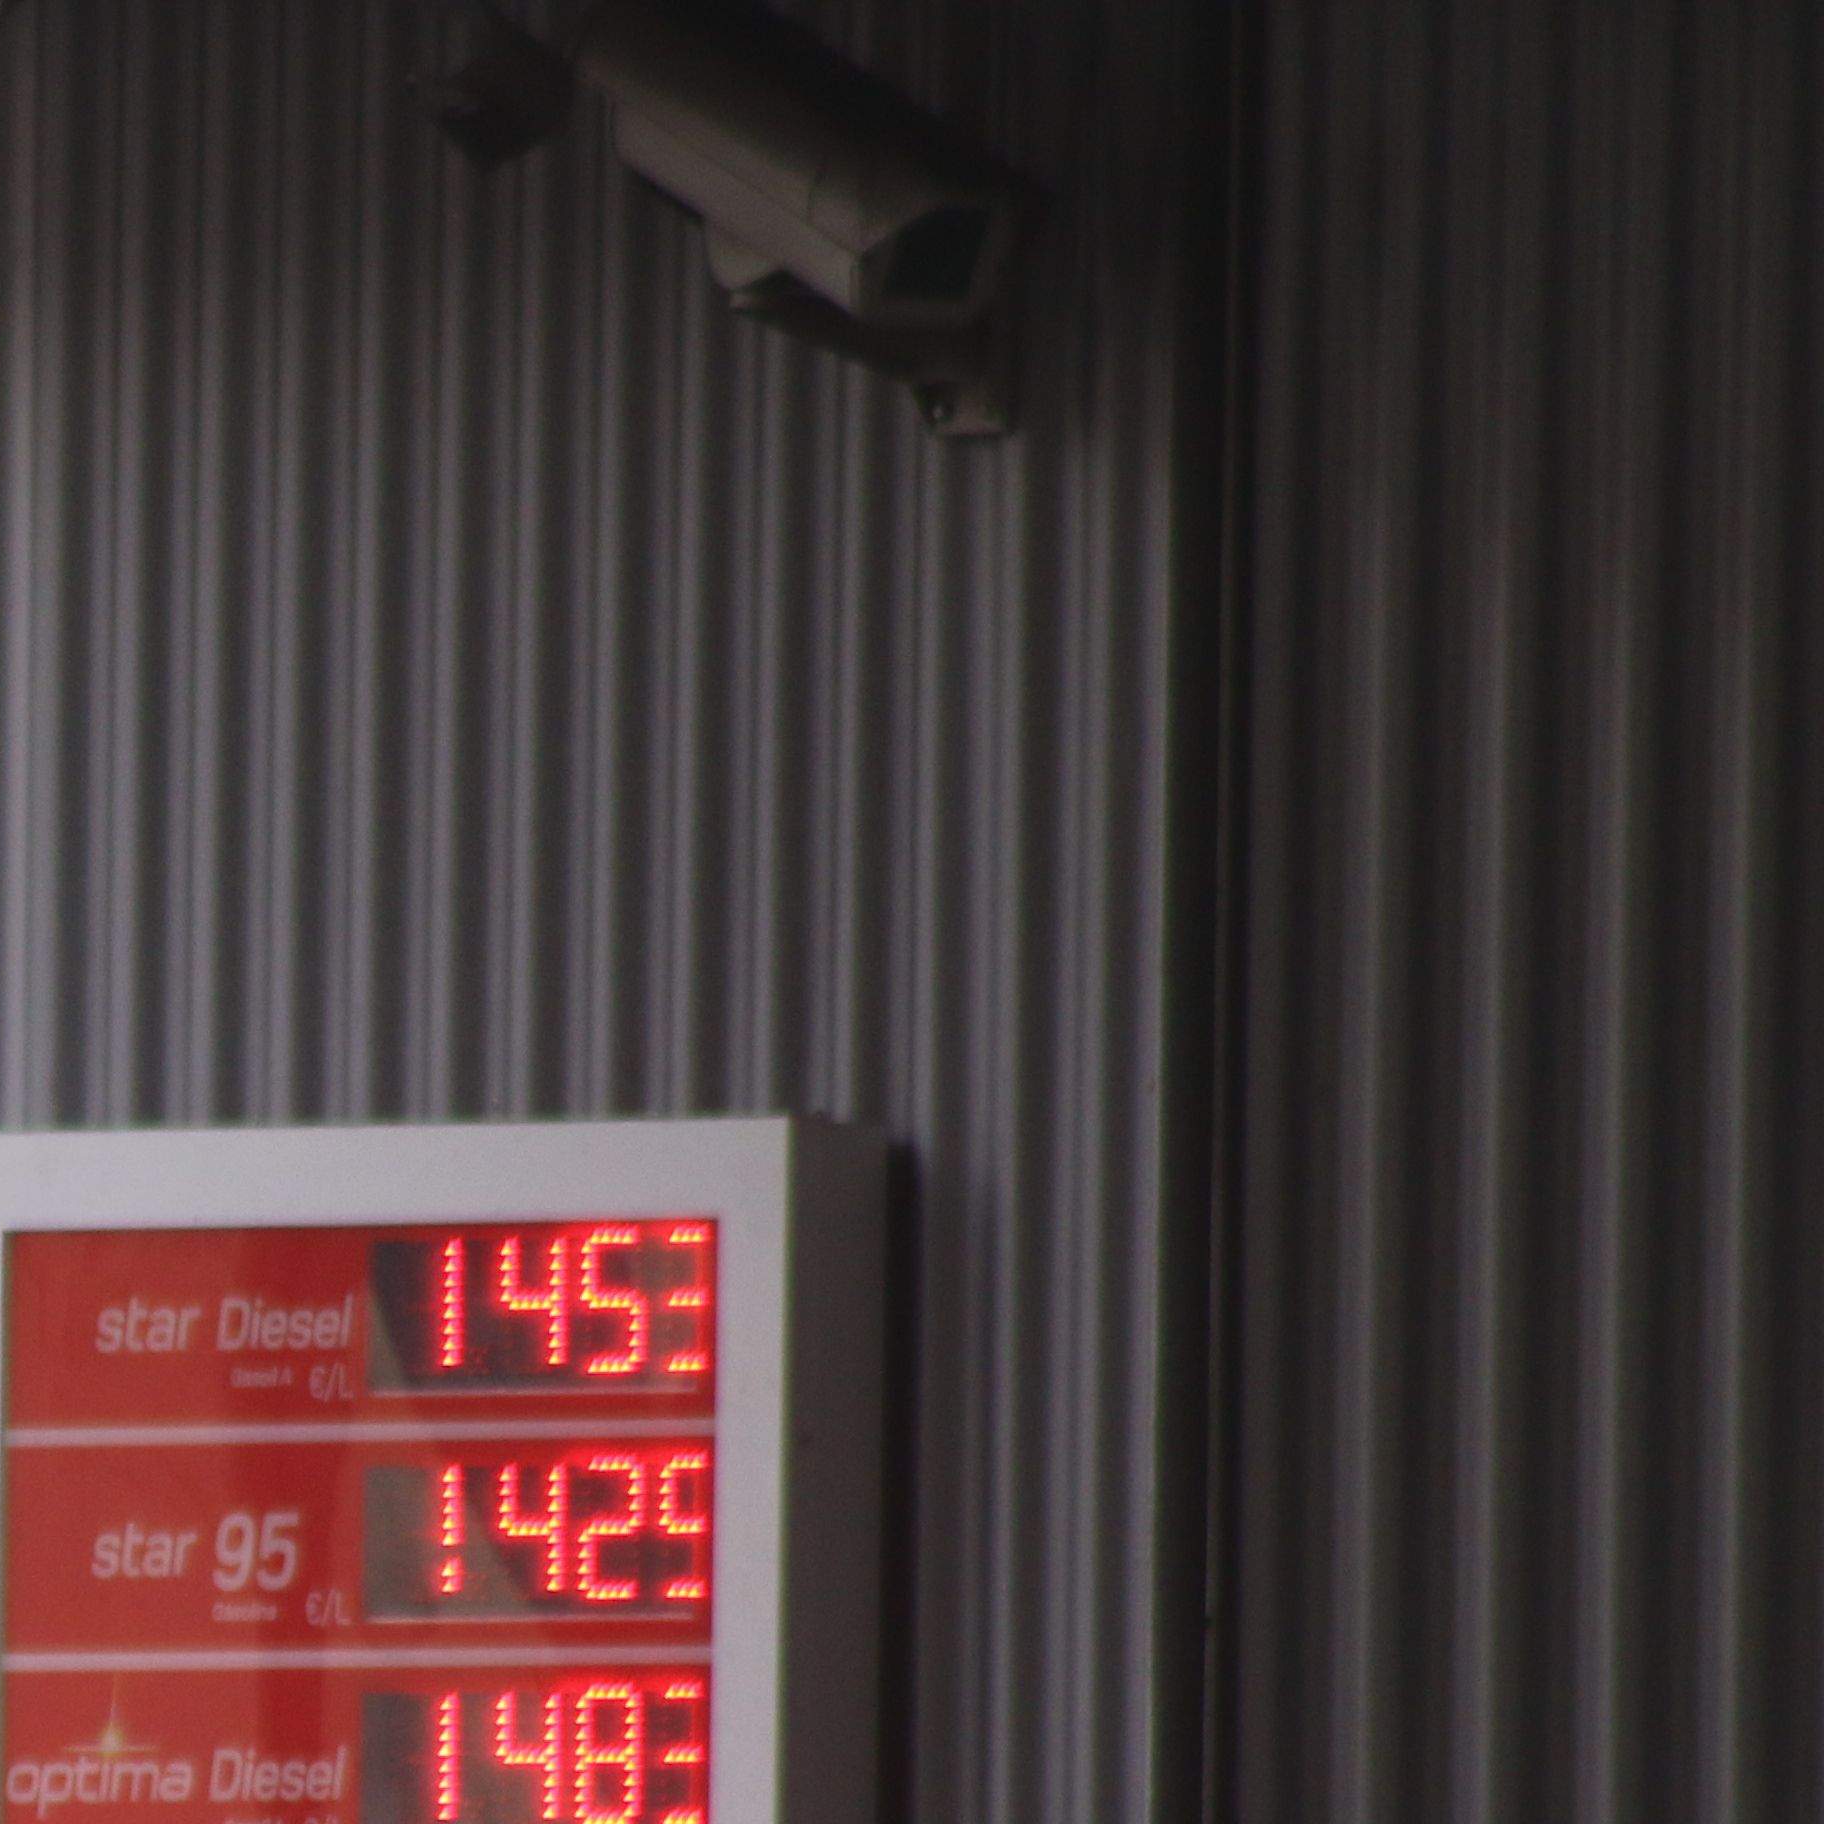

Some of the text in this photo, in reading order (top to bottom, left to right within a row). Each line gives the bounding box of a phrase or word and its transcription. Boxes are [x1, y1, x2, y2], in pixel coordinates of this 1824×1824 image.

[96, 1294, 353, 1353] star Diesel
[91, 1511, 299, 1592] star 95
[5, 1746, 347, 1821] optima Diesel
